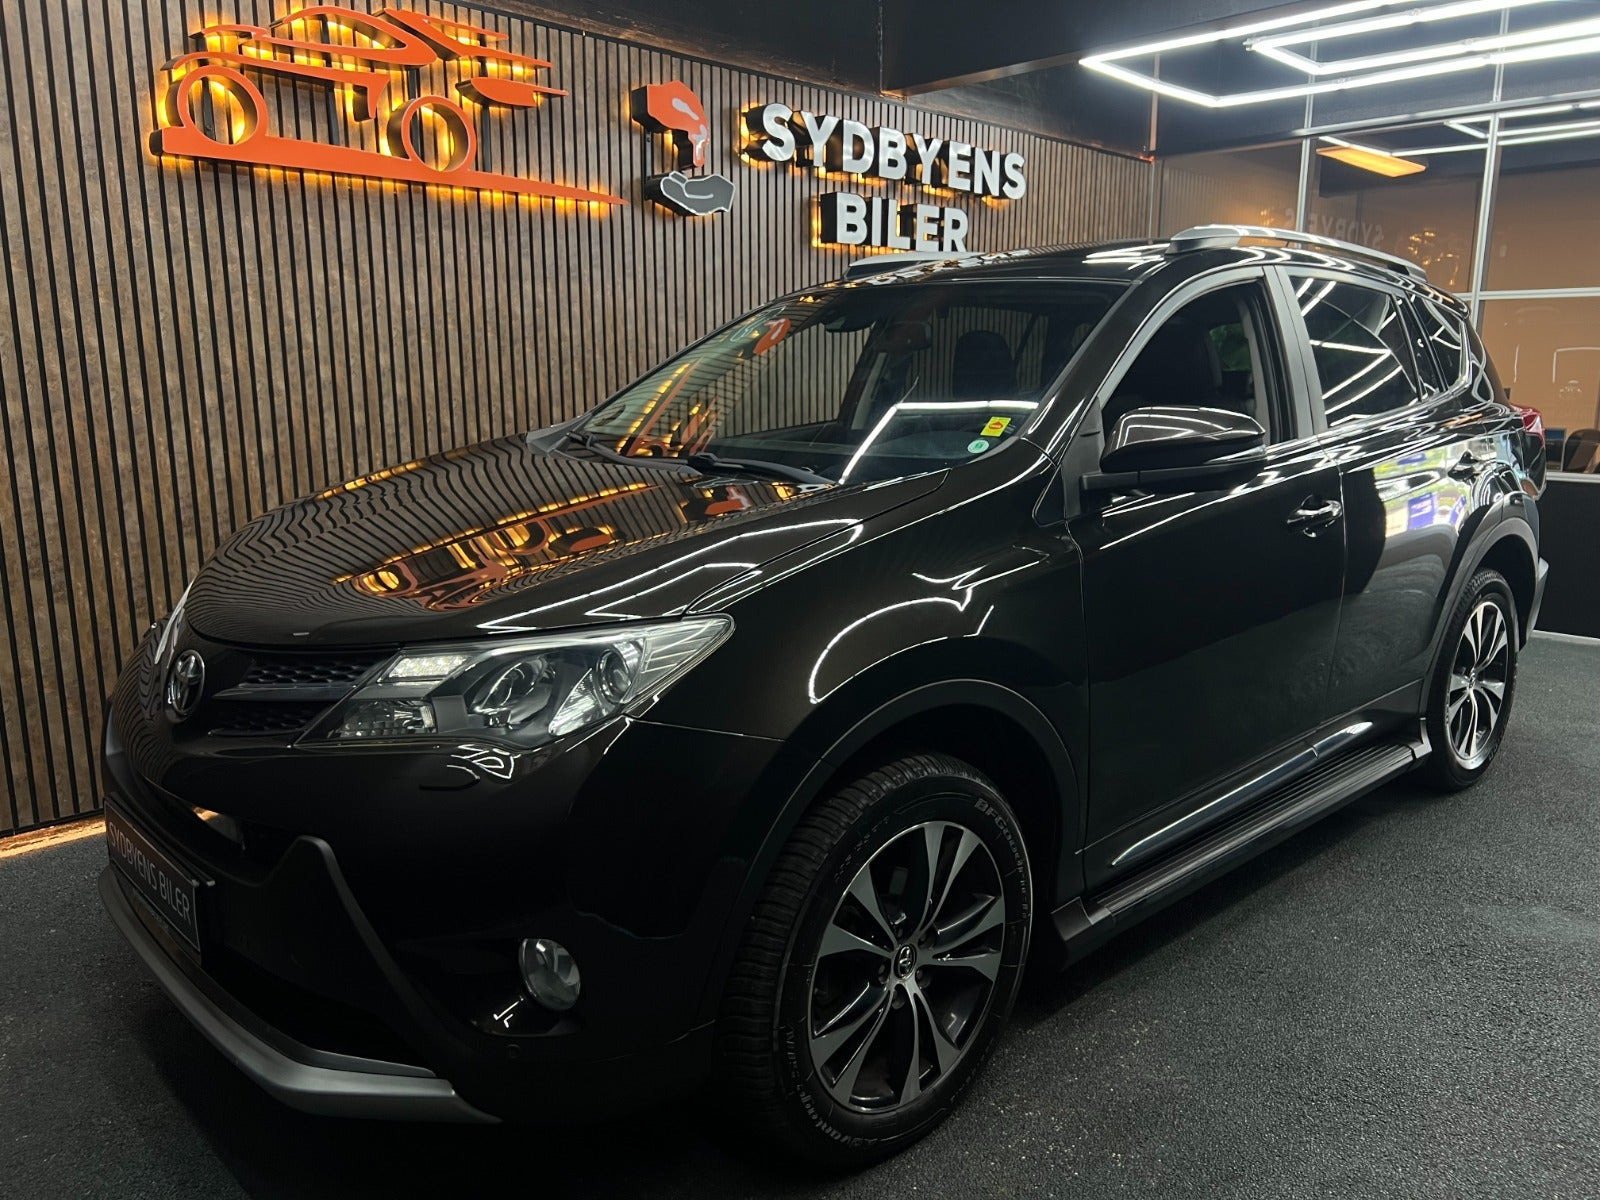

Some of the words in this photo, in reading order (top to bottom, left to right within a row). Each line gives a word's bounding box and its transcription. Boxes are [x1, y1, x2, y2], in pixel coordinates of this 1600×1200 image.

[761, 102, 1027, 200] SYDBYENS
[835, 191, 969, 253] BILER
[109, 822, 158, 890] SYDBYENS
[159, 872, 191, 925] BILER
